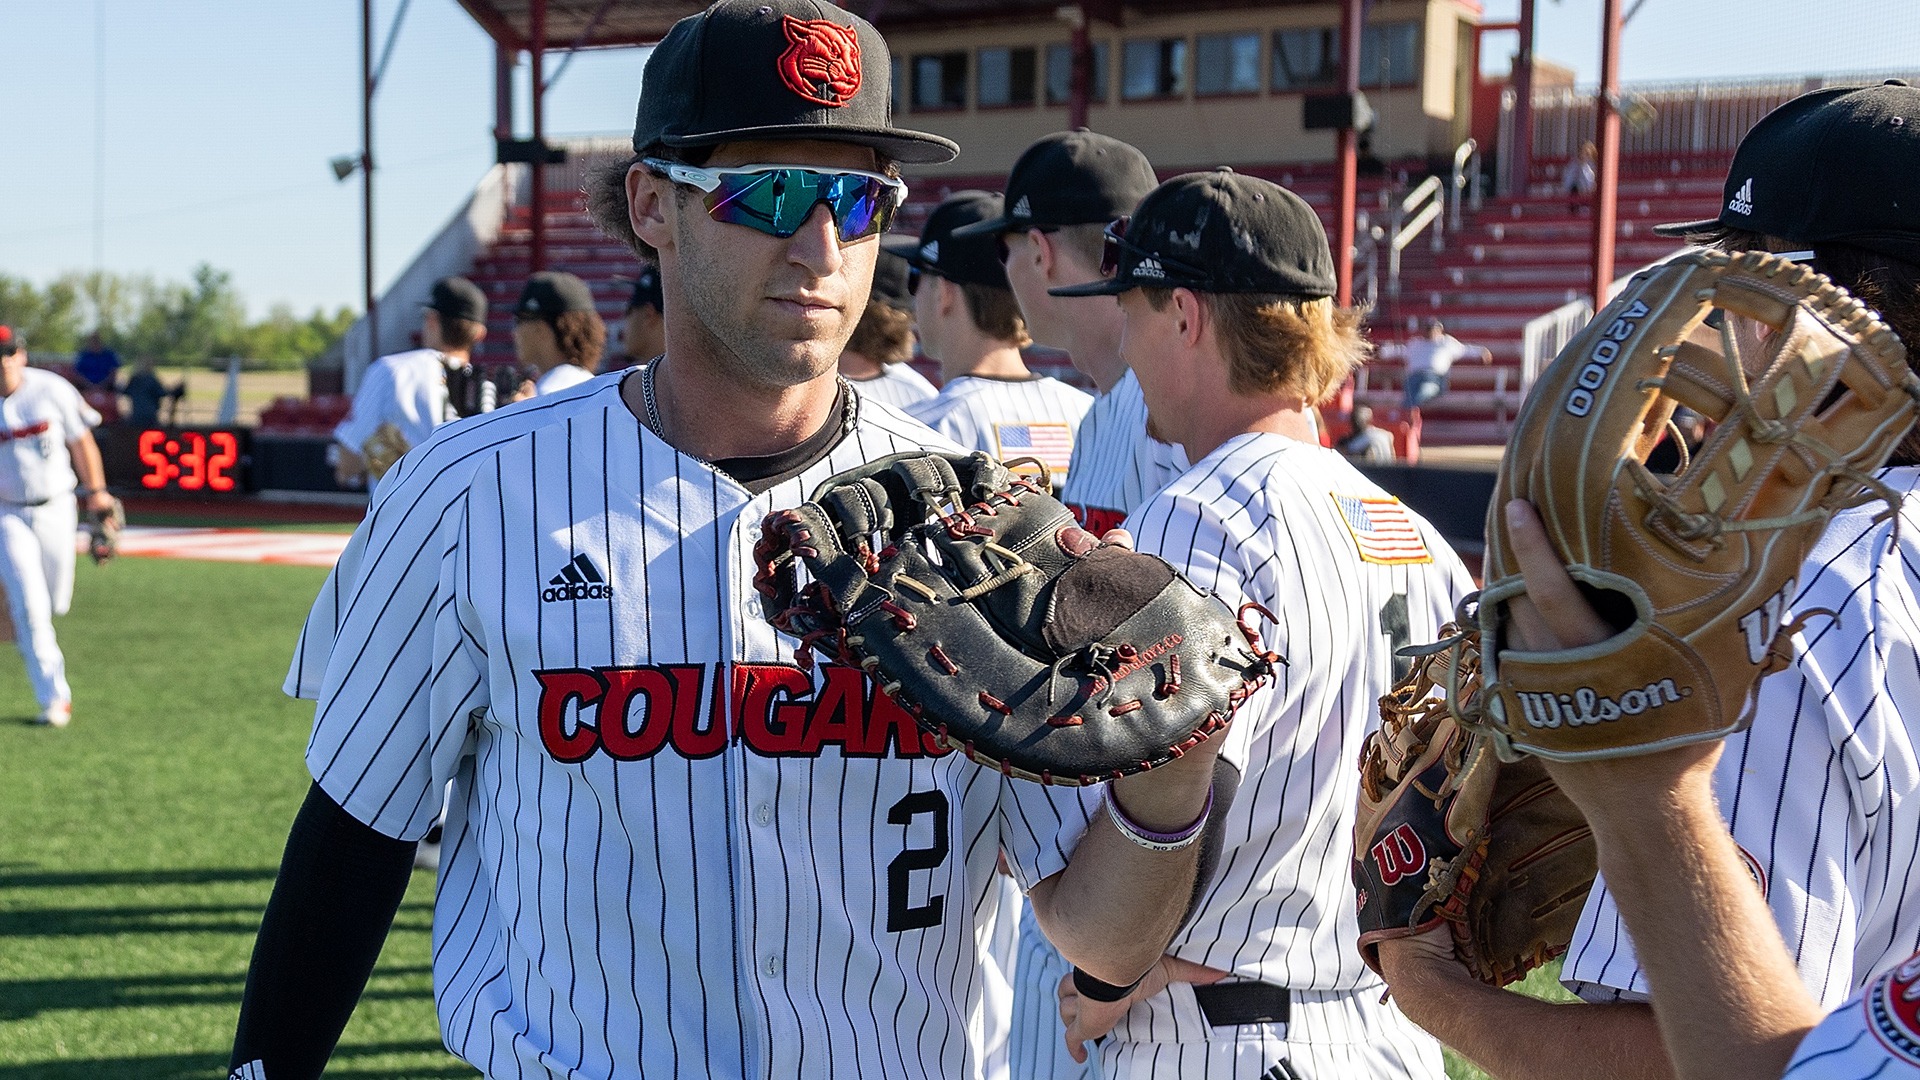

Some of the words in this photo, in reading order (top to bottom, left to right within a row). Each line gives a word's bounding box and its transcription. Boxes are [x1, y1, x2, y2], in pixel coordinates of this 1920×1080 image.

[1728, 199, 1753, 216] adidas
[1566, 299, 1651, 417] A2000
[138, 429, 238, 493] 5:32
[542, 582, 613, 603] adidas
[1515, 677, 1682, 729] Wilson
[887, 789, 950, 932] 2
[1371, 822, 1426, 886] W
